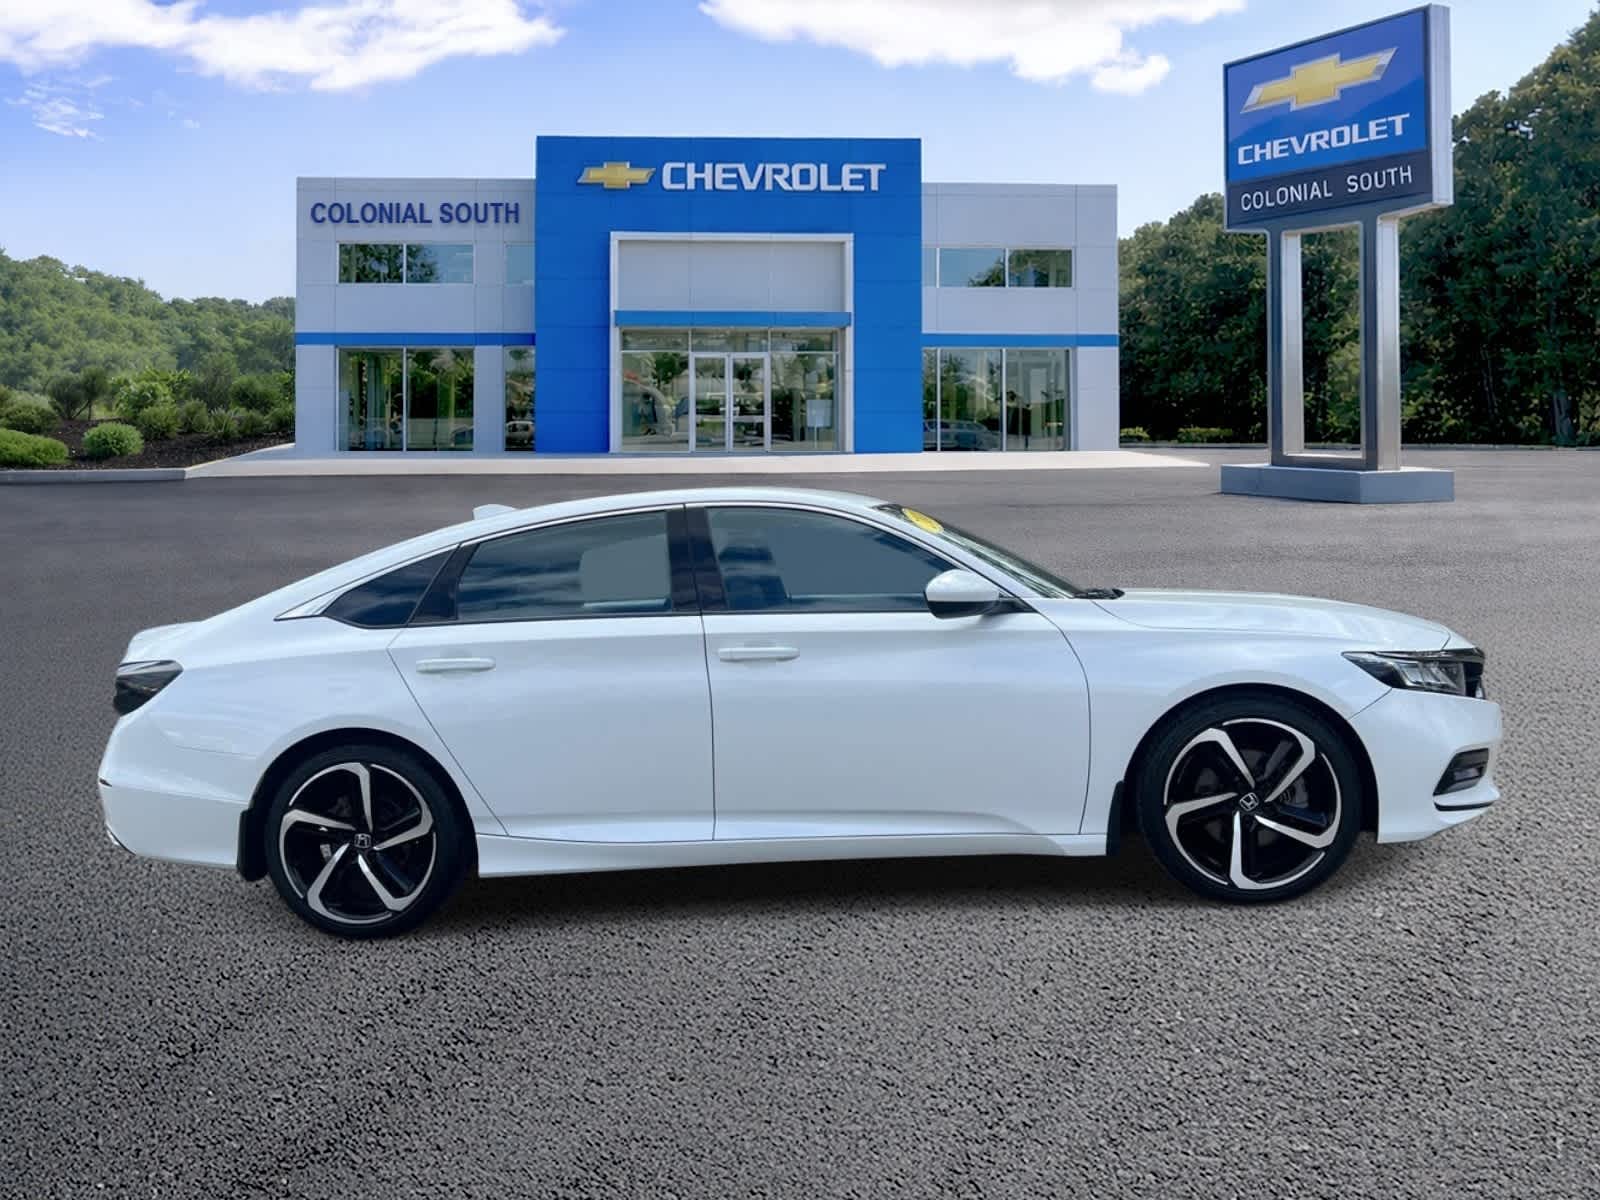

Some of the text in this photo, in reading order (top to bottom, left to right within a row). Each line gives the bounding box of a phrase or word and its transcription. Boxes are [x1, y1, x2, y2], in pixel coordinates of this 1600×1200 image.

[1238, 114, 1410, 165] CHEVROLET
[662, 162, 886, 191] CHEVROLET
[1241, 165, 1412, 211] COLONIAL SOUTH
[310, 203, 520, 224] COLONIAL SOUTH
